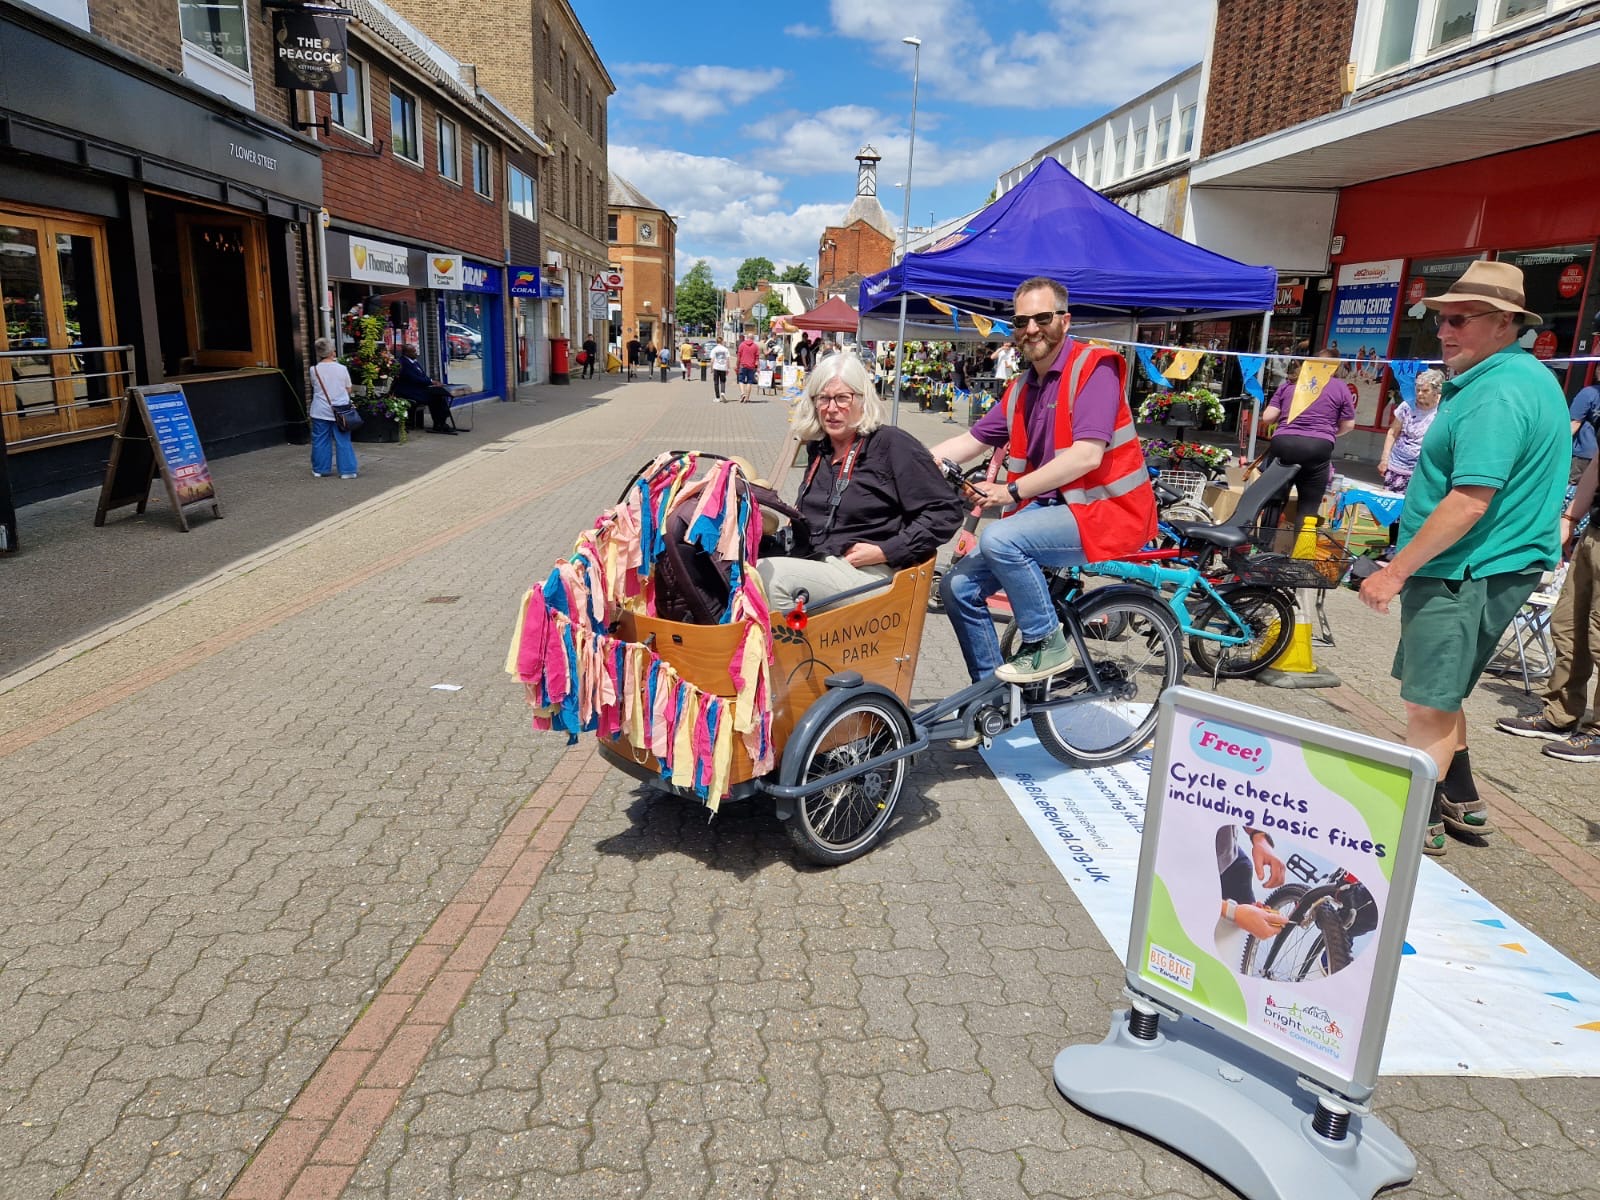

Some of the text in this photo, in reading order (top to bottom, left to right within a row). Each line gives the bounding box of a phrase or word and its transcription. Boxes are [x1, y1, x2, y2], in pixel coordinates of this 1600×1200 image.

[279, 47, 341, 64] PEACOCK
[297, 37, 322, 49] THE
[229, 142, 277, 171] 7 LOWER STREET
[368, 252, 394, 273] Thomas
[462, 266, 484, 287] ORAL
[1274, 288, 1293, 305] UM
[1339, 297, 1392, 315] BOOKING CENTRE
[820, 612, 901, 649] HANWOOD
[842, 640, 880, 664] PARK
[1199, 730, 1263, 762] Free!
[1170, 762, 1227, 790] Cycle
[1235, 780, 1308, 814] checks
[1015, 772, 1111, 883] BigBikeRevival.org.uk
[1169, 785, 1387, 858] including basic fixes
[1151, 950, 1191, 980] BIG BIKE
[1273, 1022, 1287, 1033] the
[1289, 1030, 1340, 1059] community
